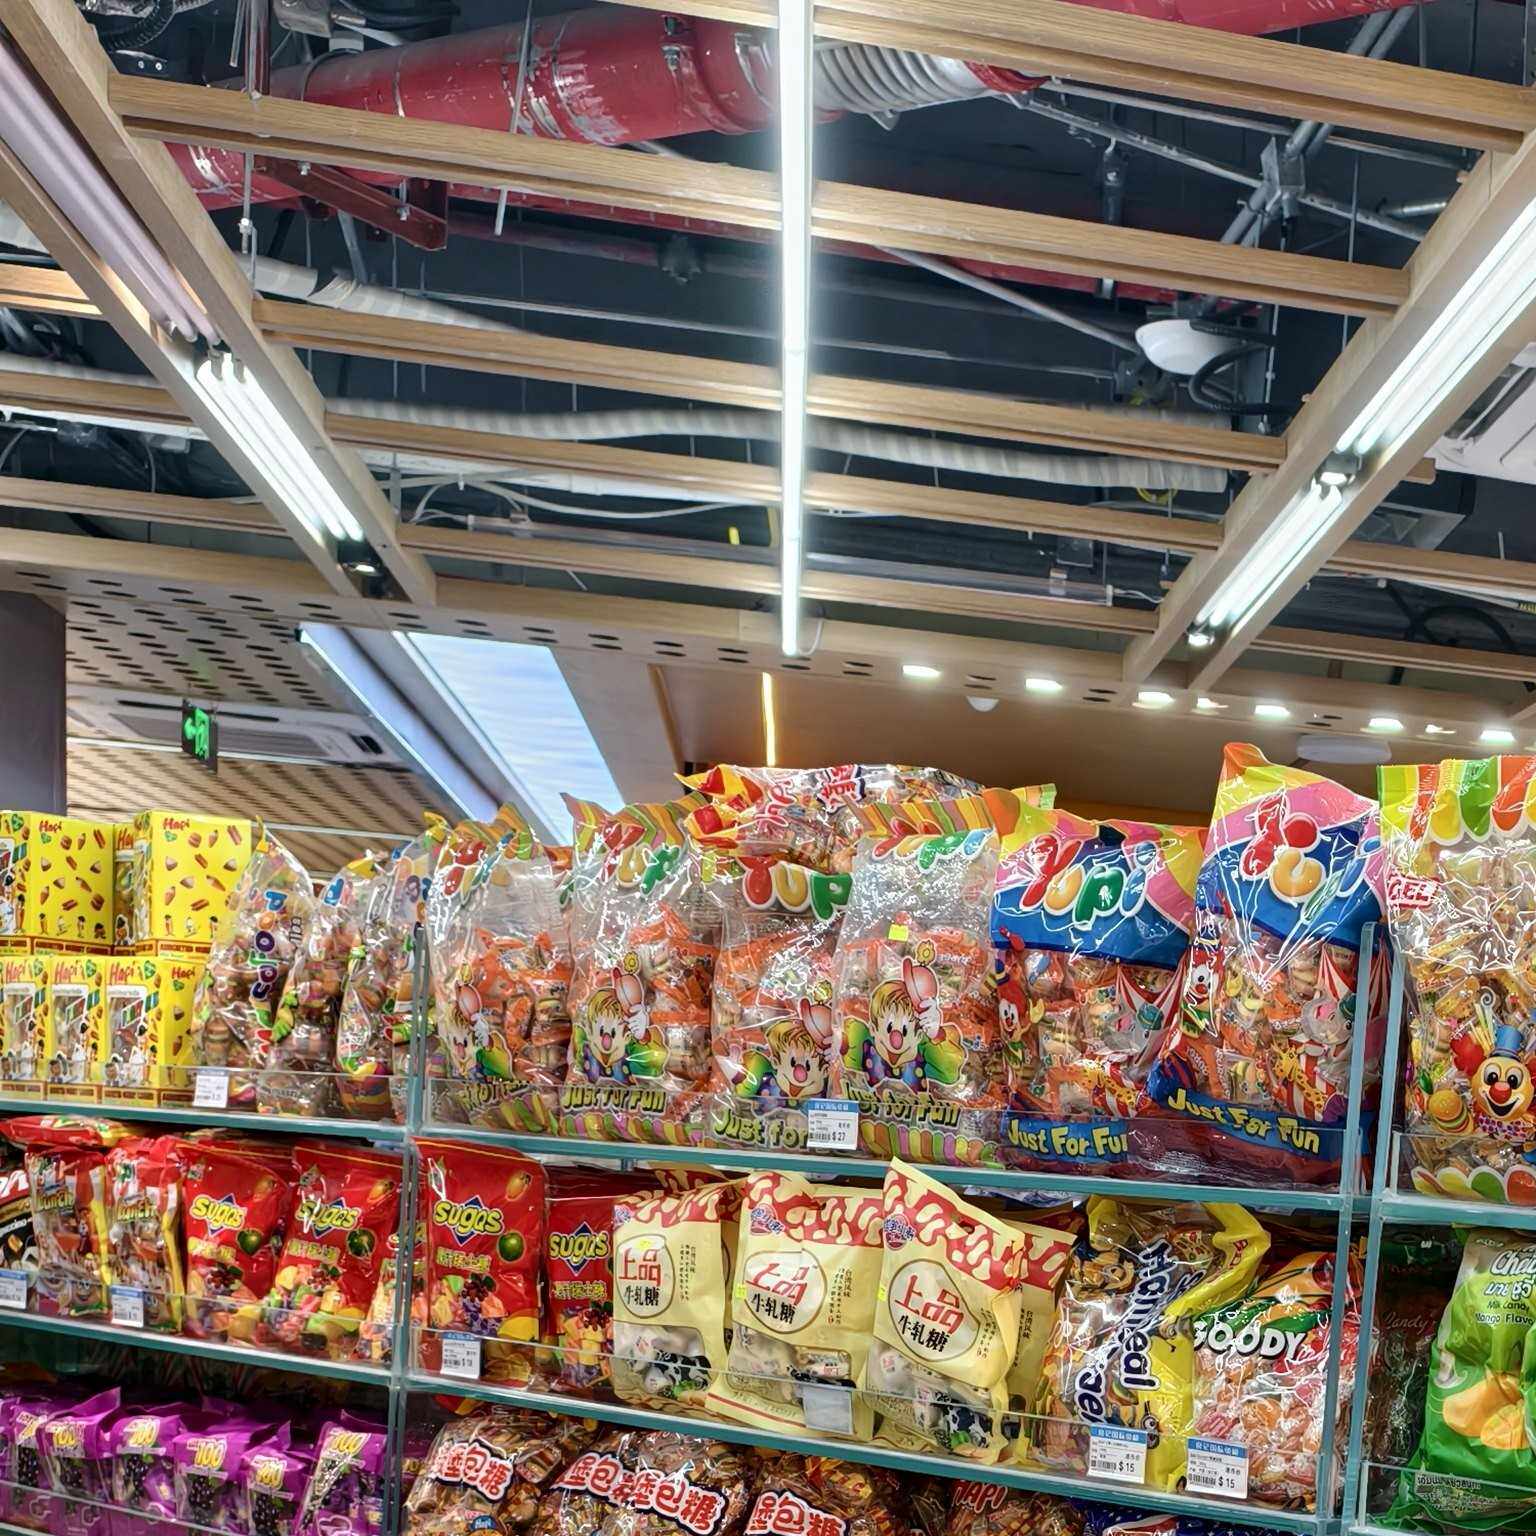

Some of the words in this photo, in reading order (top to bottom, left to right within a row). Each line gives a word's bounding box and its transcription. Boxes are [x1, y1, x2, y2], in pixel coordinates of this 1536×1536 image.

[1022, 835, 1160, 929] Yupi
[1389, 877, 1437, 904] GEL
[1168, 1088, 1226, 1125] Just
[1278, 1118, 1321, 1153] Fun
[1009, 1123, 1050, 1154] Just
[1053, 1126, 1089, 1155] For
[619, 1249, 662, 1285] 上品
[746, 1259, 807, 1305] 上品
[623, 1285, 660, 1308] 牛轧糖
[751, 1294, 796, 1325] 牛轧糖
[894, 1273, 965, 1333] 上品
[897, 1315, 949, 1352] 牛轧糖
[1119, 1461, 1123, 1472] $
[1126, 1462, 1134, 1472] 15
[1219, 1477, 1223, 1486] $
[1226, 1478, 1235, 1488] 15
